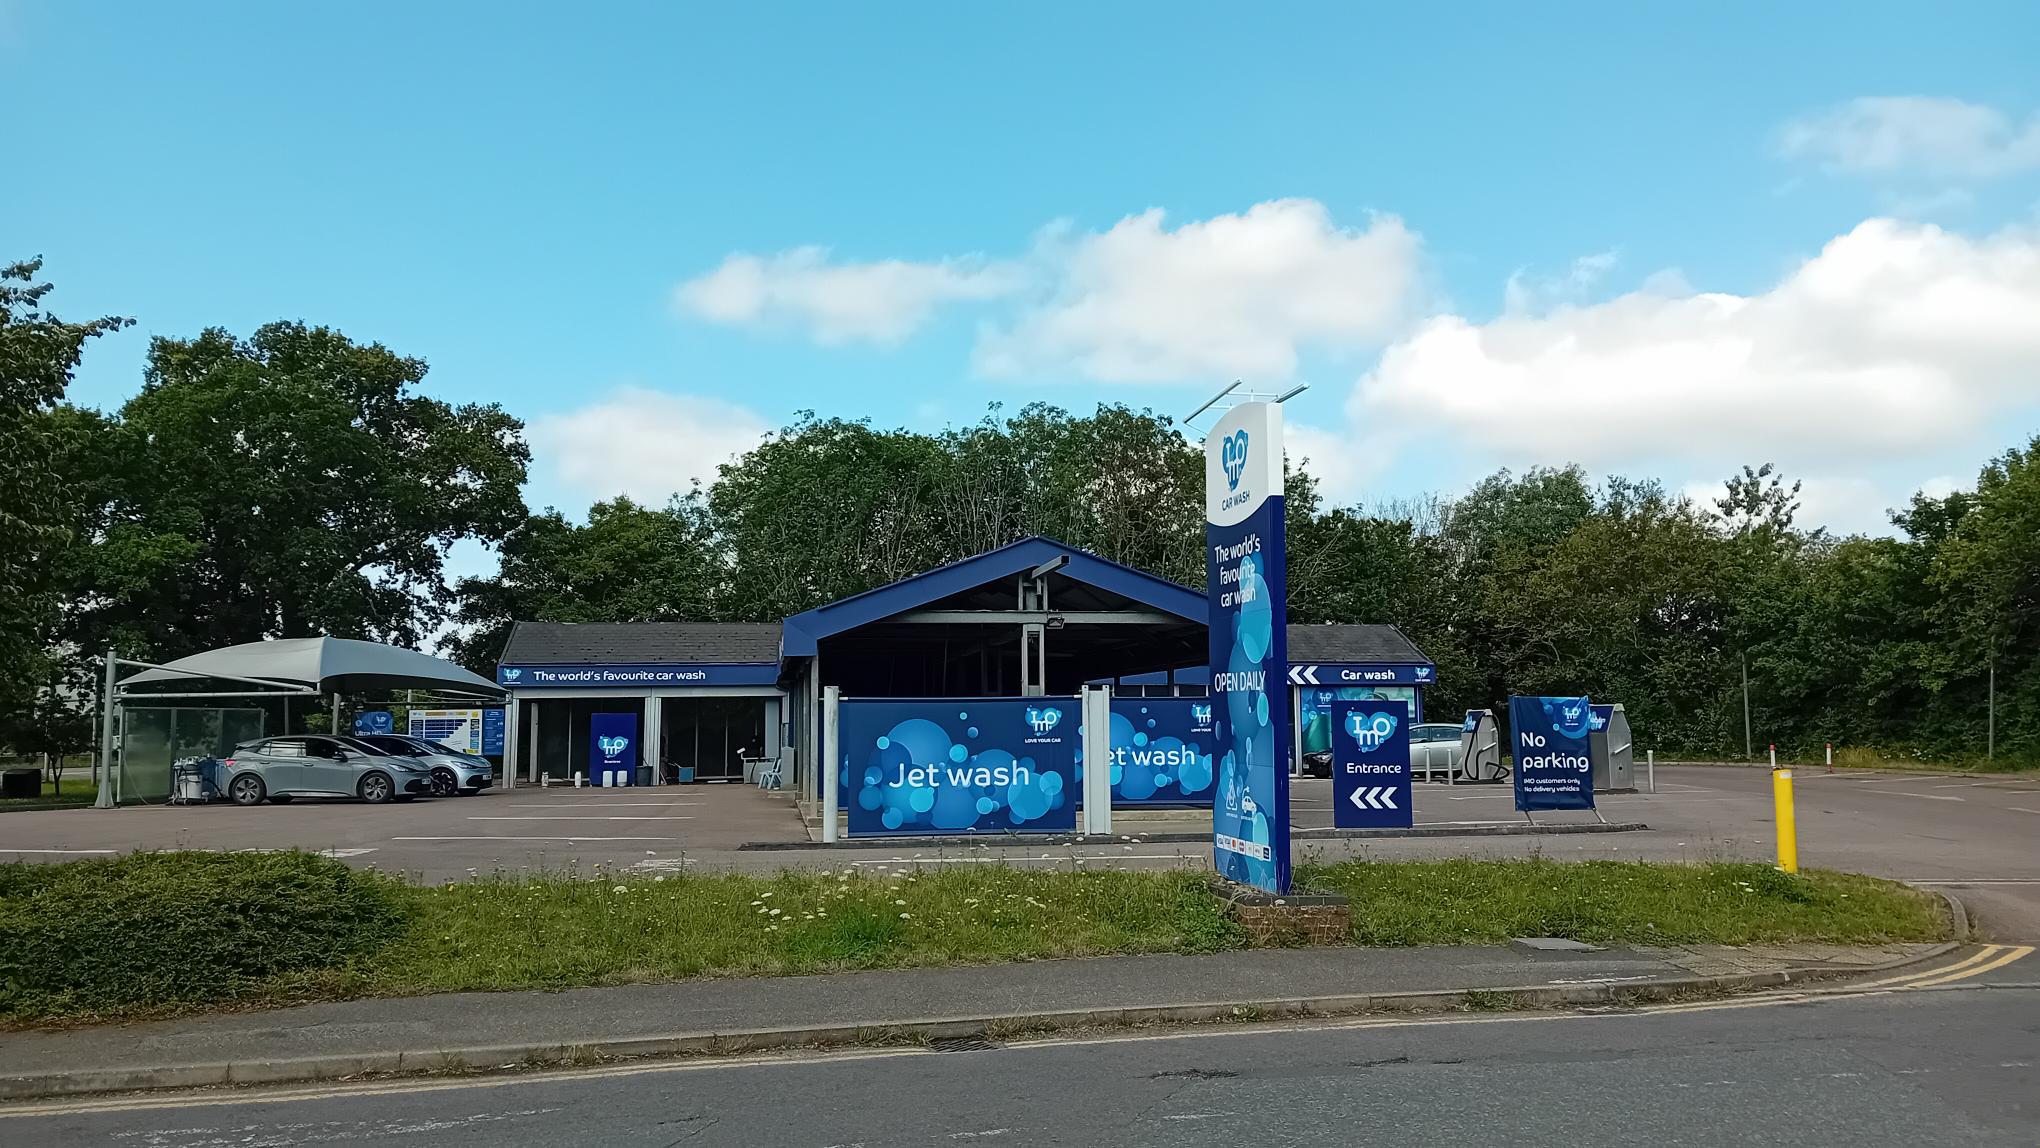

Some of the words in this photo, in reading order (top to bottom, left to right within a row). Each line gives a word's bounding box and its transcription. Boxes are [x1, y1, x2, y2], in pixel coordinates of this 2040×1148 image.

[1221, 497, 1232, 511] CAR
[1233, 490, 1250, 507] WASH
[1214, 545, 1230, 564] The
[1230, 533, 1261, 559] world's
[1219, 563, 1255, 586] favourite
[1221, 591, 1233, 608] car
[1233, 583, 1256, 605] wash
[533, 671, 556, 681] The
[558, 671, 600, 681] world's
[603, 671, 655, 681] favourite
[676, 671, 706, 680] wash
[1214, 671, 1239, 693] OPEN
[1239, 670, 1266, 692] DAILY
[1341, 669, 1361, 680] Car
[1364, 669, 1396, 680] wash
[1521, 733, 1546, 747] No
[1109, 747, 1126, 766] et
[1131, 745, 1195, 766] wash
[1522, 752, 1589, 773] parking
[889, 762, 940, 789] Jet
[946, 760, 1030, 787] wash
[1346, 763, 1402, 774] Entrance
[1567, 778, 1581, 786] only
